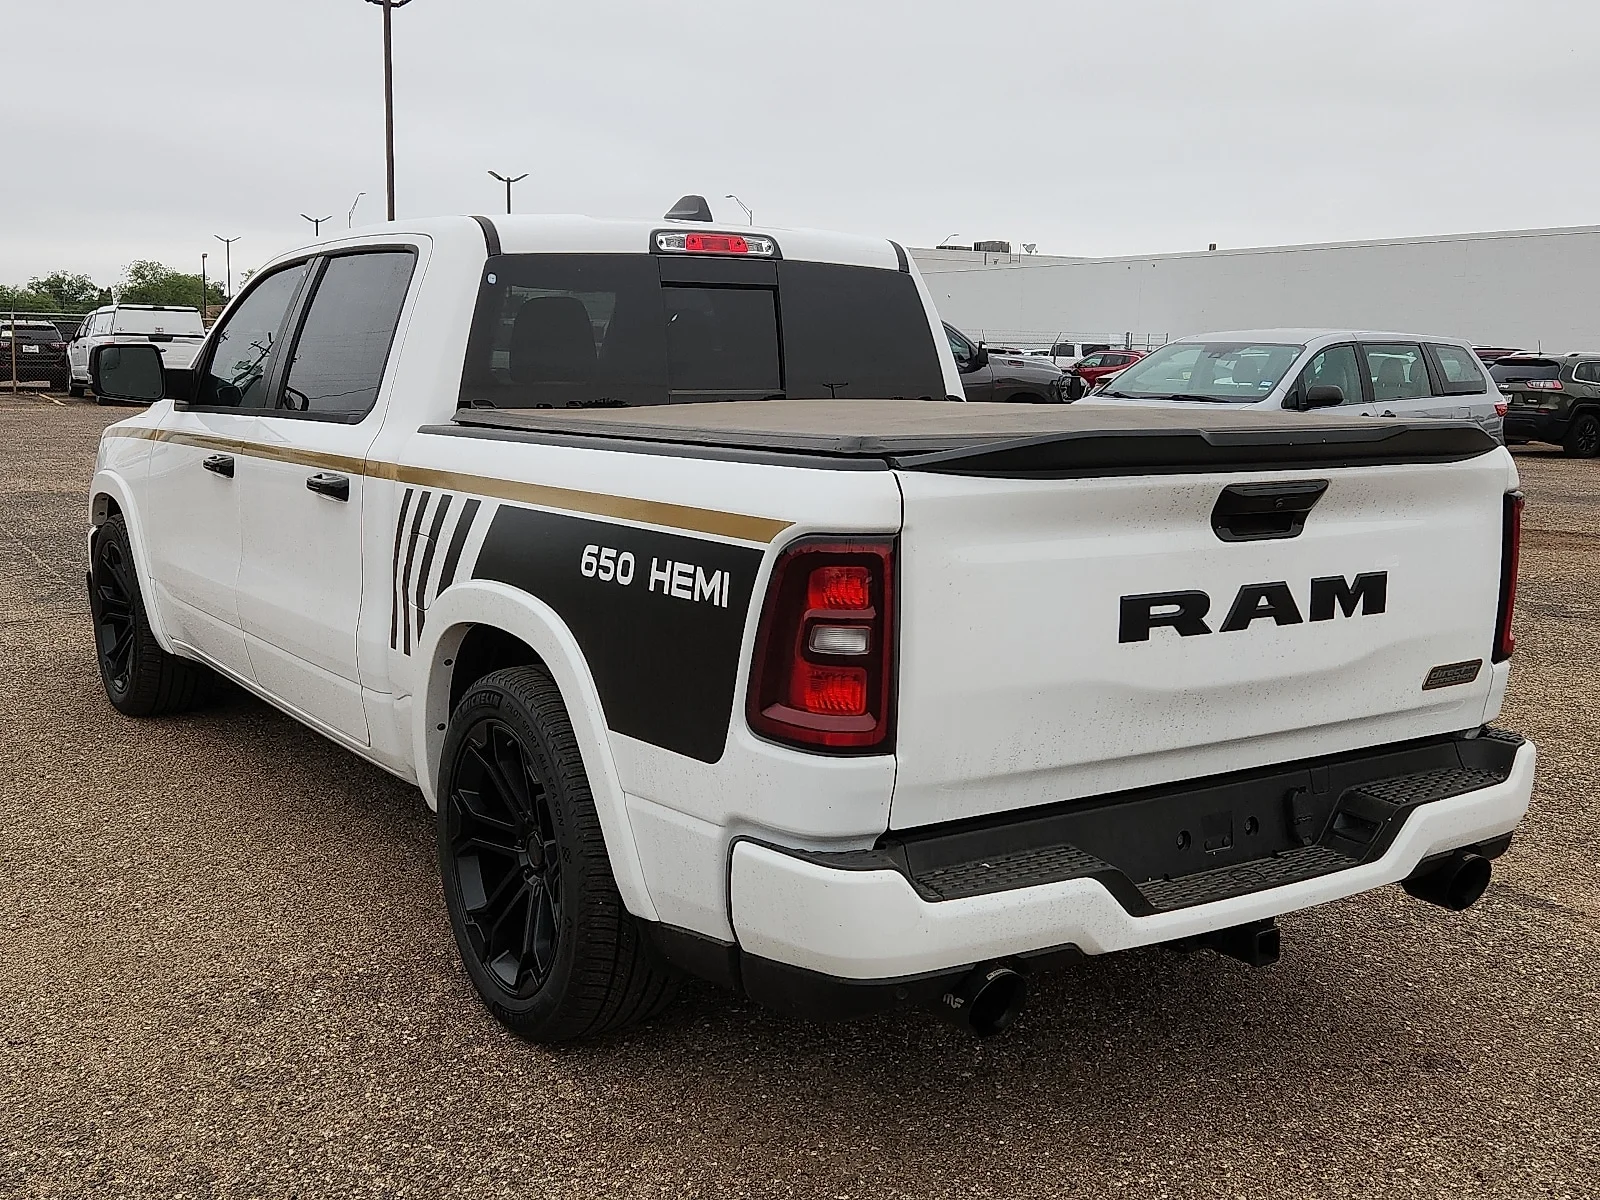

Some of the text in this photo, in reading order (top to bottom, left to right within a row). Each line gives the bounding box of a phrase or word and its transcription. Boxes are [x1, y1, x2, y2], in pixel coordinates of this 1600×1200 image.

[580, 544, 731, 609] 650 HEMI
[1118, 571, 1388, 643] RAM
[462, 692, 501, 712] MICHELIN
[1430, 666, 1467, 679] direct
[506, 702, 564, 826] PILOT SPORT ALL SEASON
